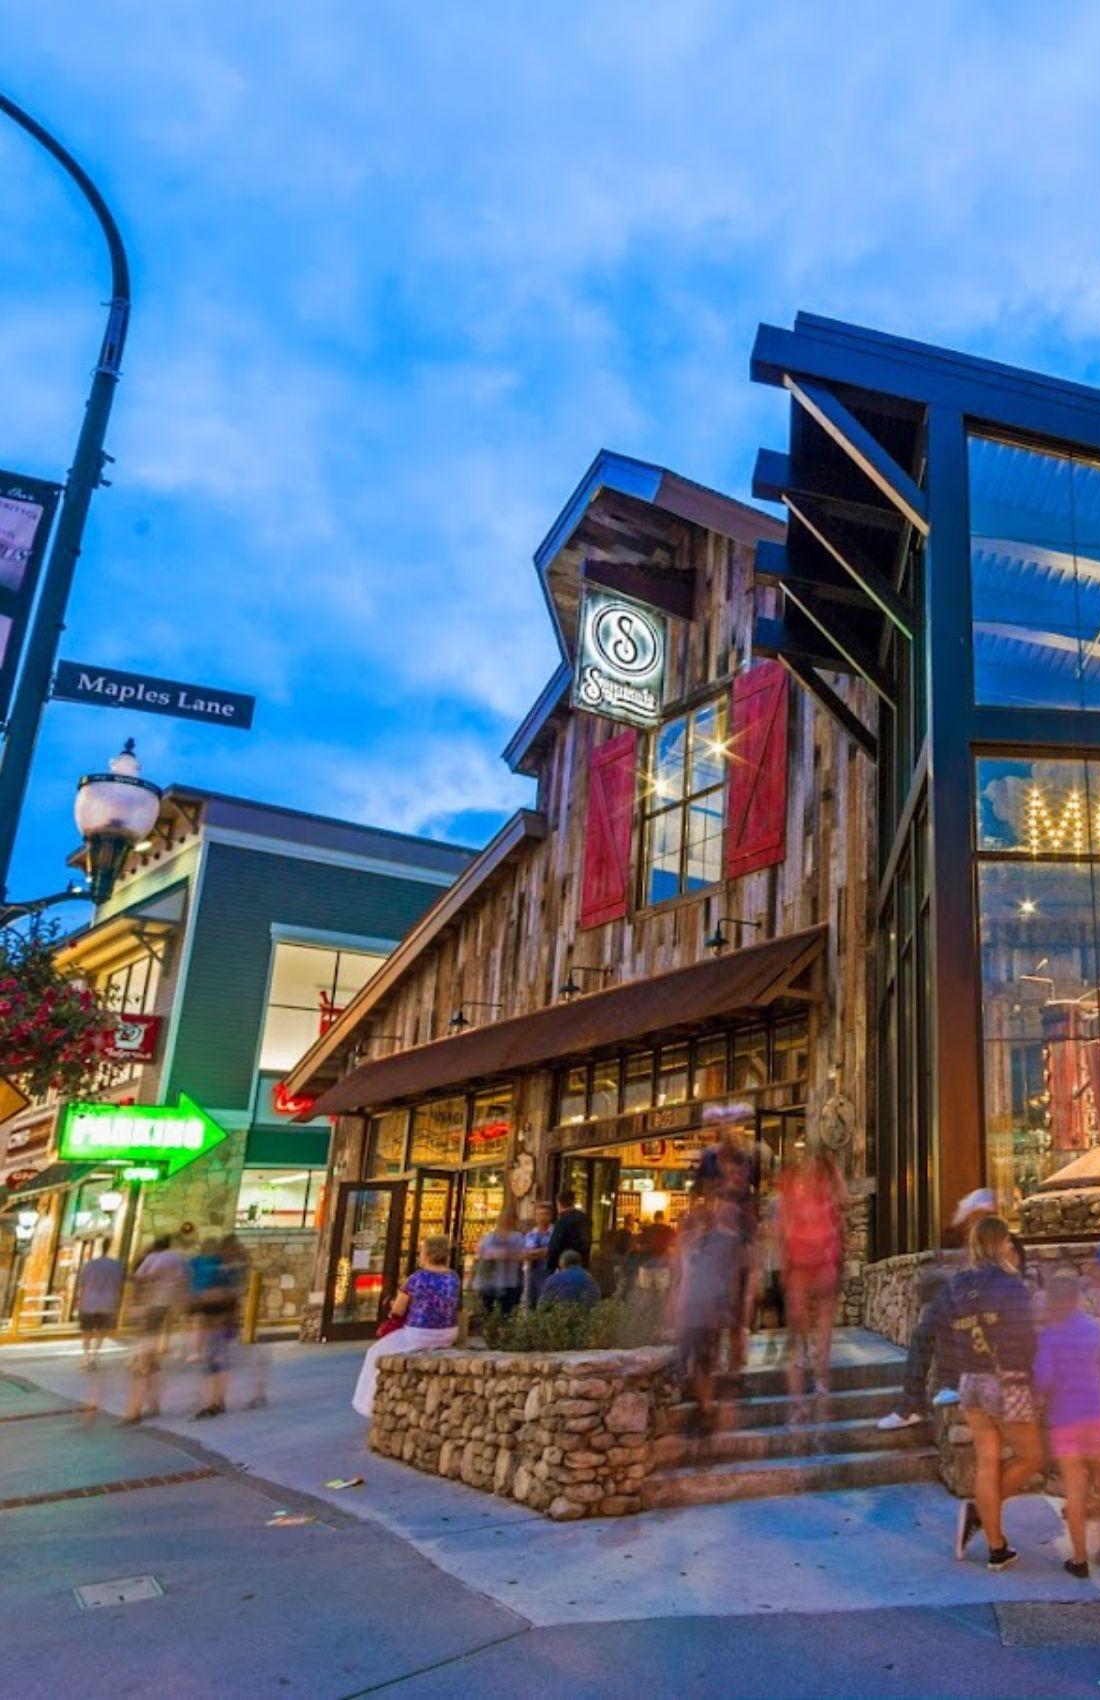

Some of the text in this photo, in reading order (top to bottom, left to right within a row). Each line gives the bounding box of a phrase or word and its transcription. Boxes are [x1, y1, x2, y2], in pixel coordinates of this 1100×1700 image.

[612, 615, 638, 665] S
[76, 673, 235, 716] Maples Lane
[70, 1115, 204, 1149] PARKING
